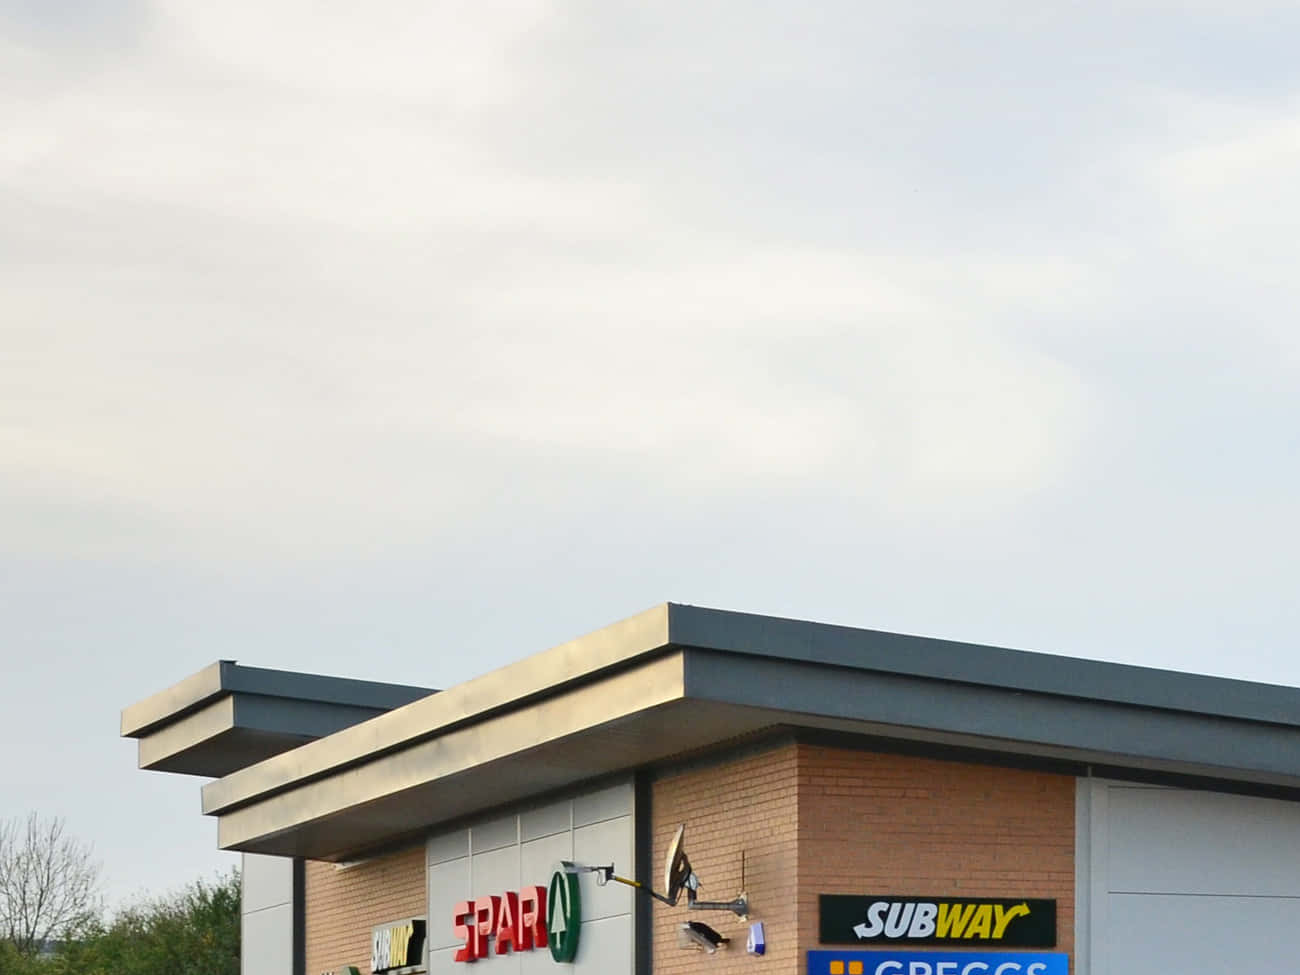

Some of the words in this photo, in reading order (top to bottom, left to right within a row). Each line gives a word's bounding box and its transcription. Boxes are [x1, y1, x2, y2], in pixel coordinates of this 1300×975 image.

[453, 886, 548, 962] SPAR
[853, 901, 1031, 940] SUBWAY
[371, 921, 414, 973] SUBWAY
